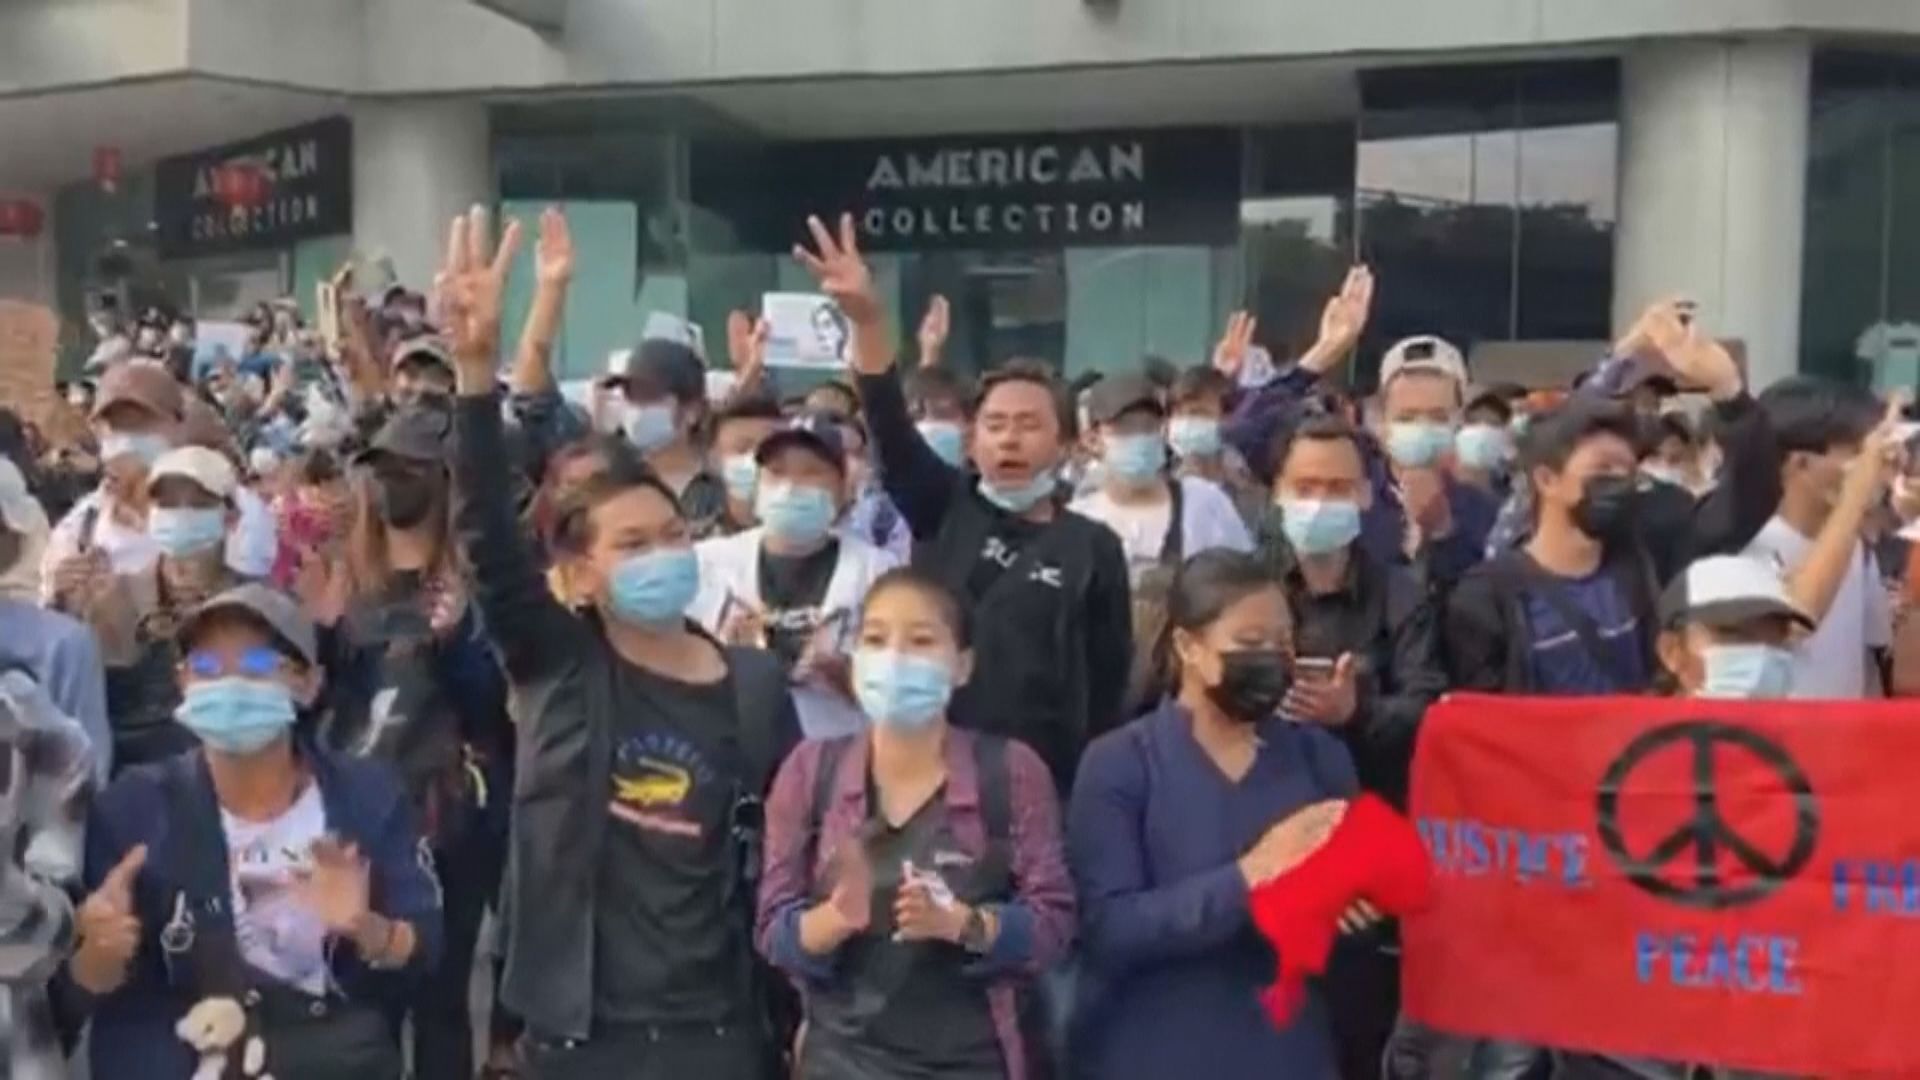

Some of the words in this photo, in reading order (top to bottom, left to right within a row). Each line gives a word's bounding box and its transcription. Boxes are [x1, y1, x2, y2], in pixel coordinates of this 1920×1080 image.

[867, 143, 1144, 188] AMERICAN
[865, 202, 1144, 235] COLLECTION
[1636, 931, 1803, 994] PEACE
